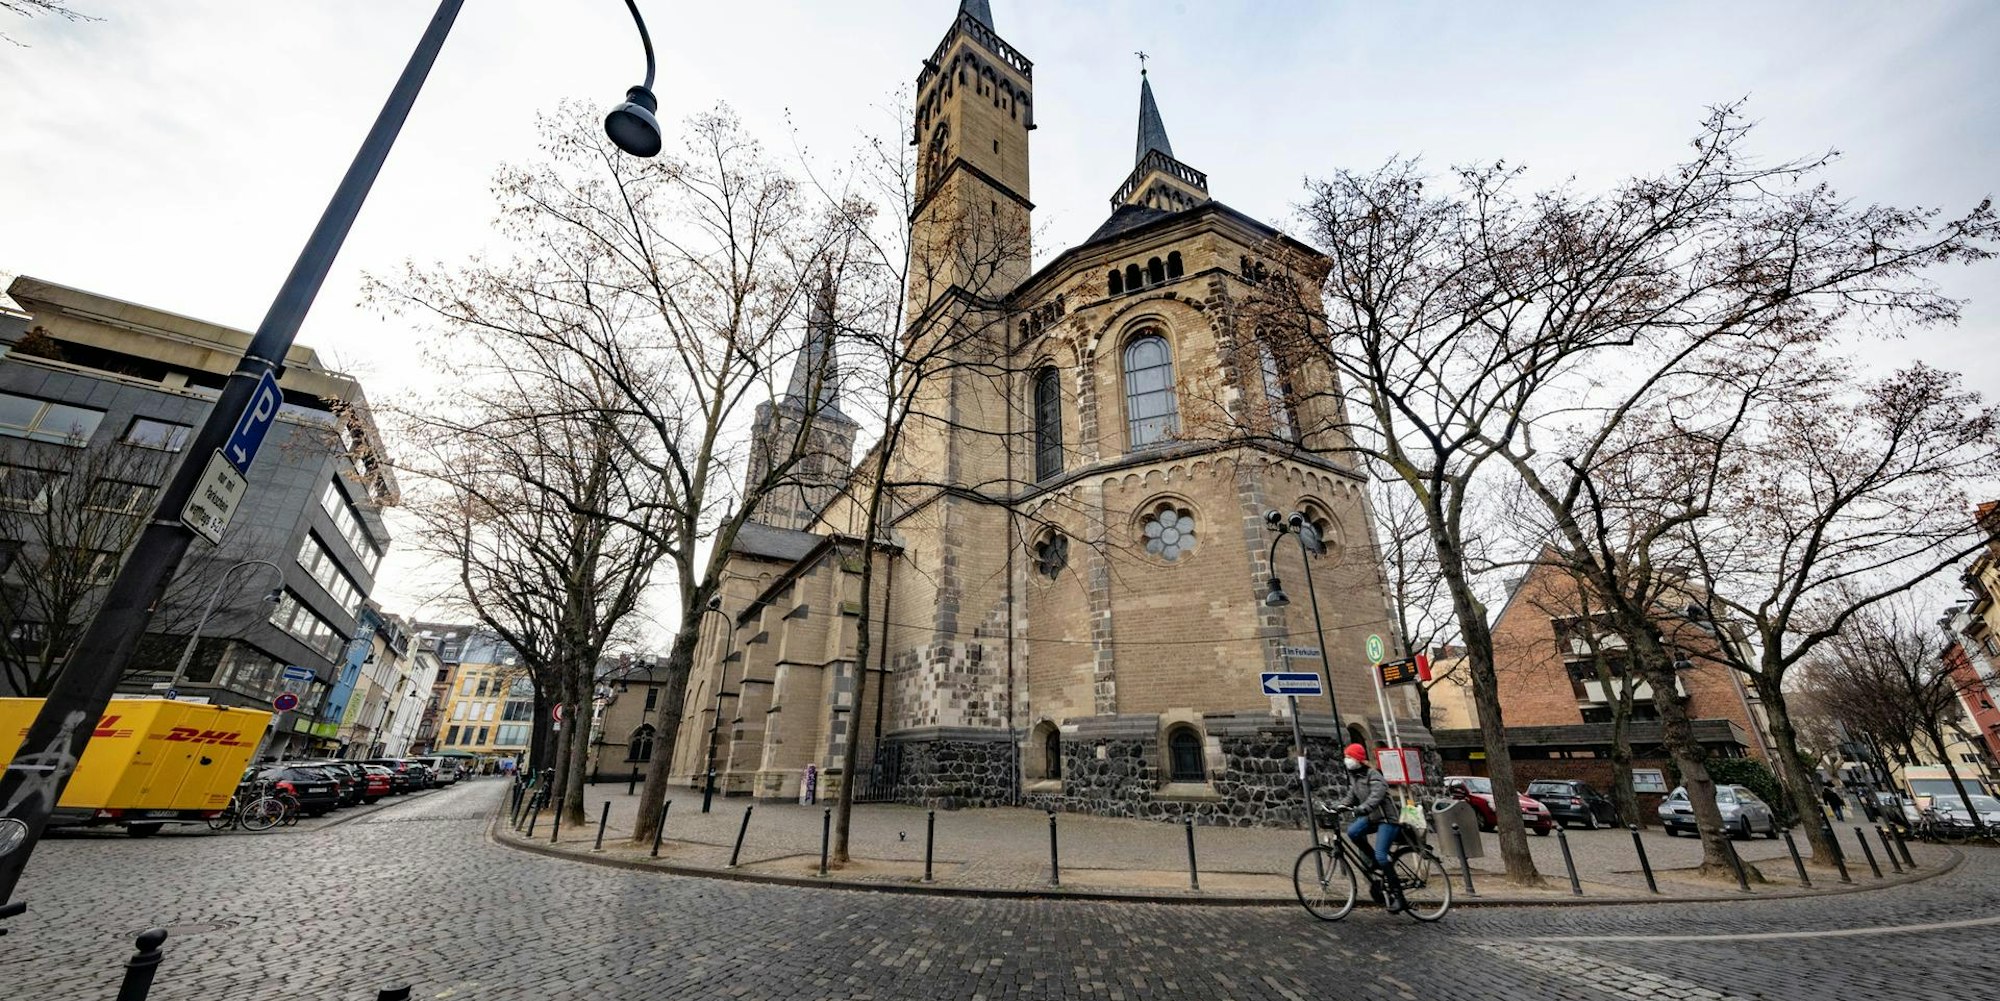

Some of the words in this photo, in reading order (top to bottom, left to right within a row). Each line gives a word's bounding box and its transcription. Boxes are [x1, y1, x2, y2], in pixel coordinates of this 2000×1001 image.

[242, 386, 274, 437] P
[204, 484, 229, 514] Parkschein
[164, 727, 241, 746] DHL
